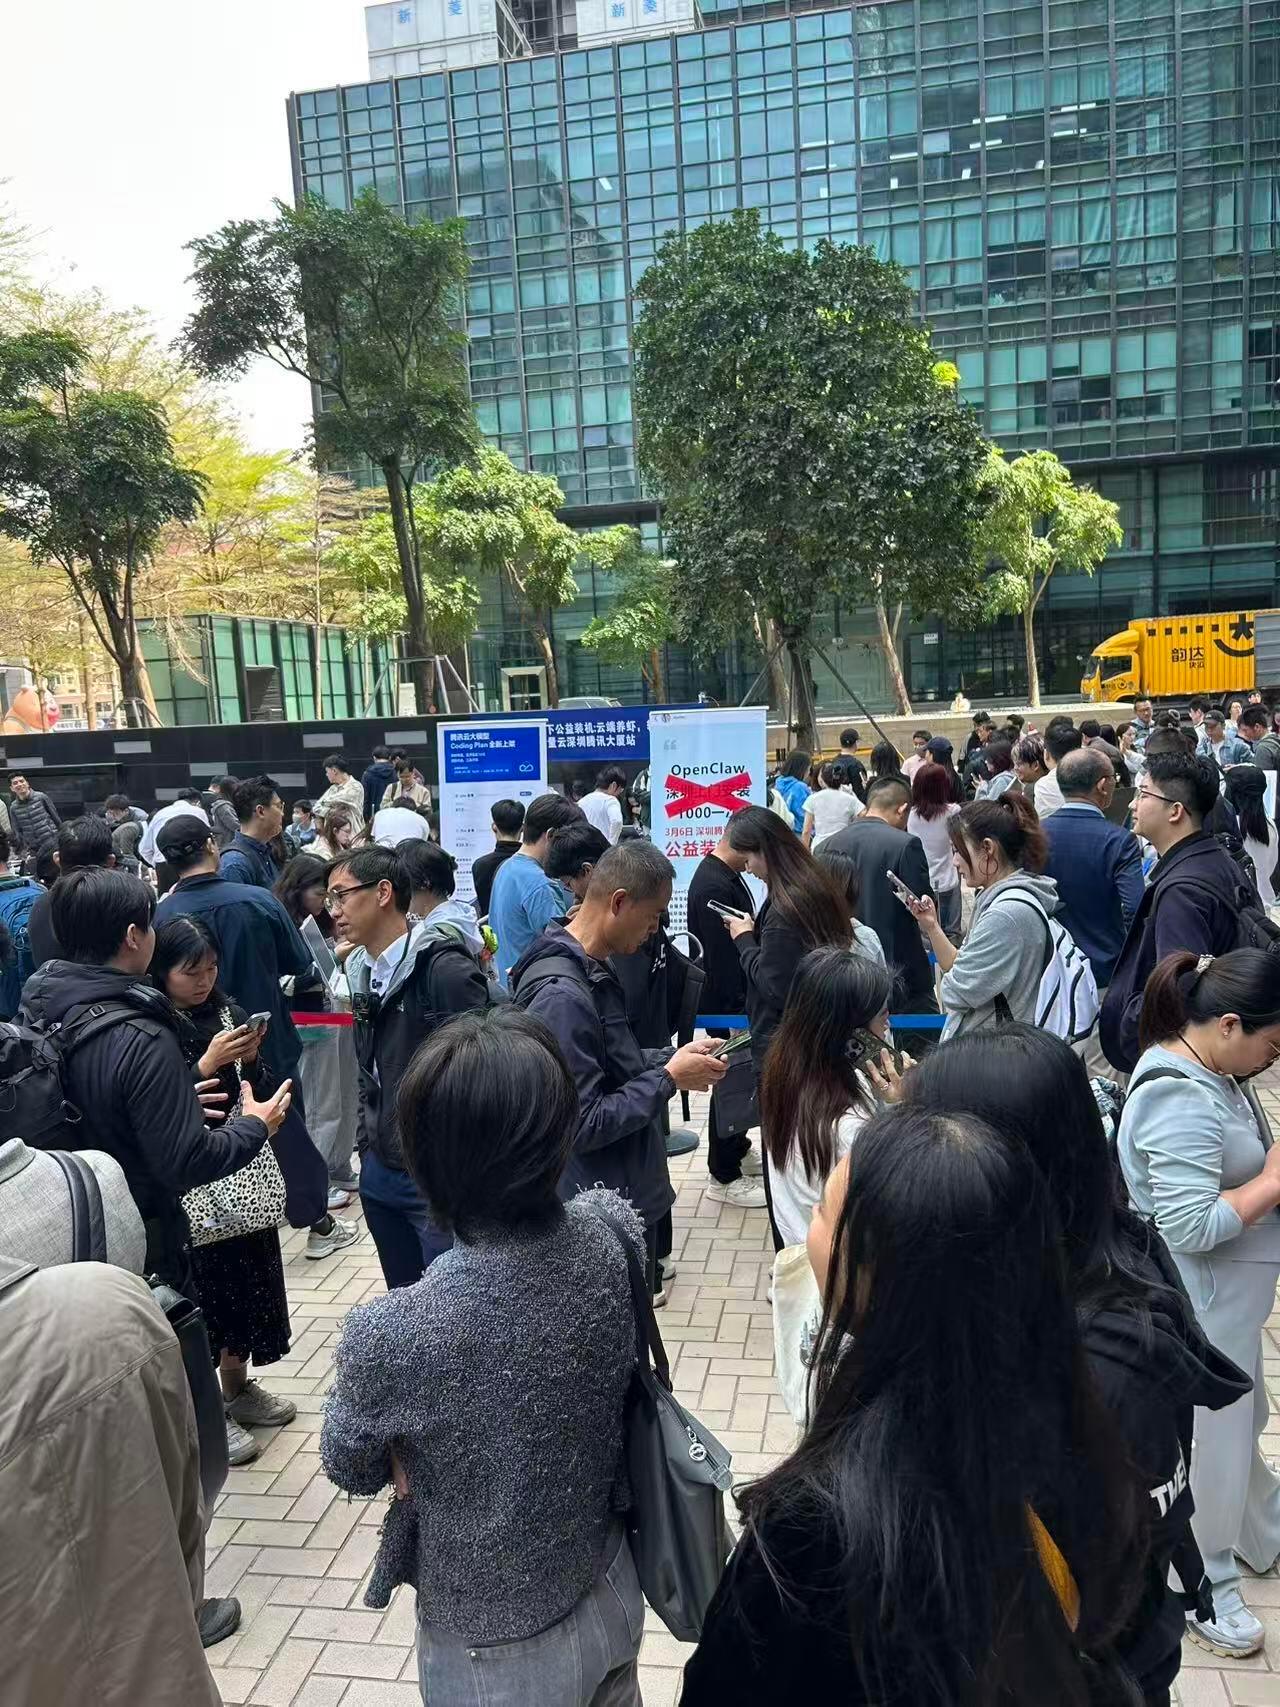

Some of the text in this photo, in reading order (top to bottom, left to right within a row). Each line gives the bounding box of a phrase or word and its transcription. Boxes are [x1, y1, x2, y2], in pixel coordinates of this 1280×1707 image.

[1171, 646, 1205, 663] 韵达
[671, 762, 745, 778] OpenClaw
[665, 825, 726, 837] 3月6日 深圳腾
[666, 839, 718, 858] 公益装
